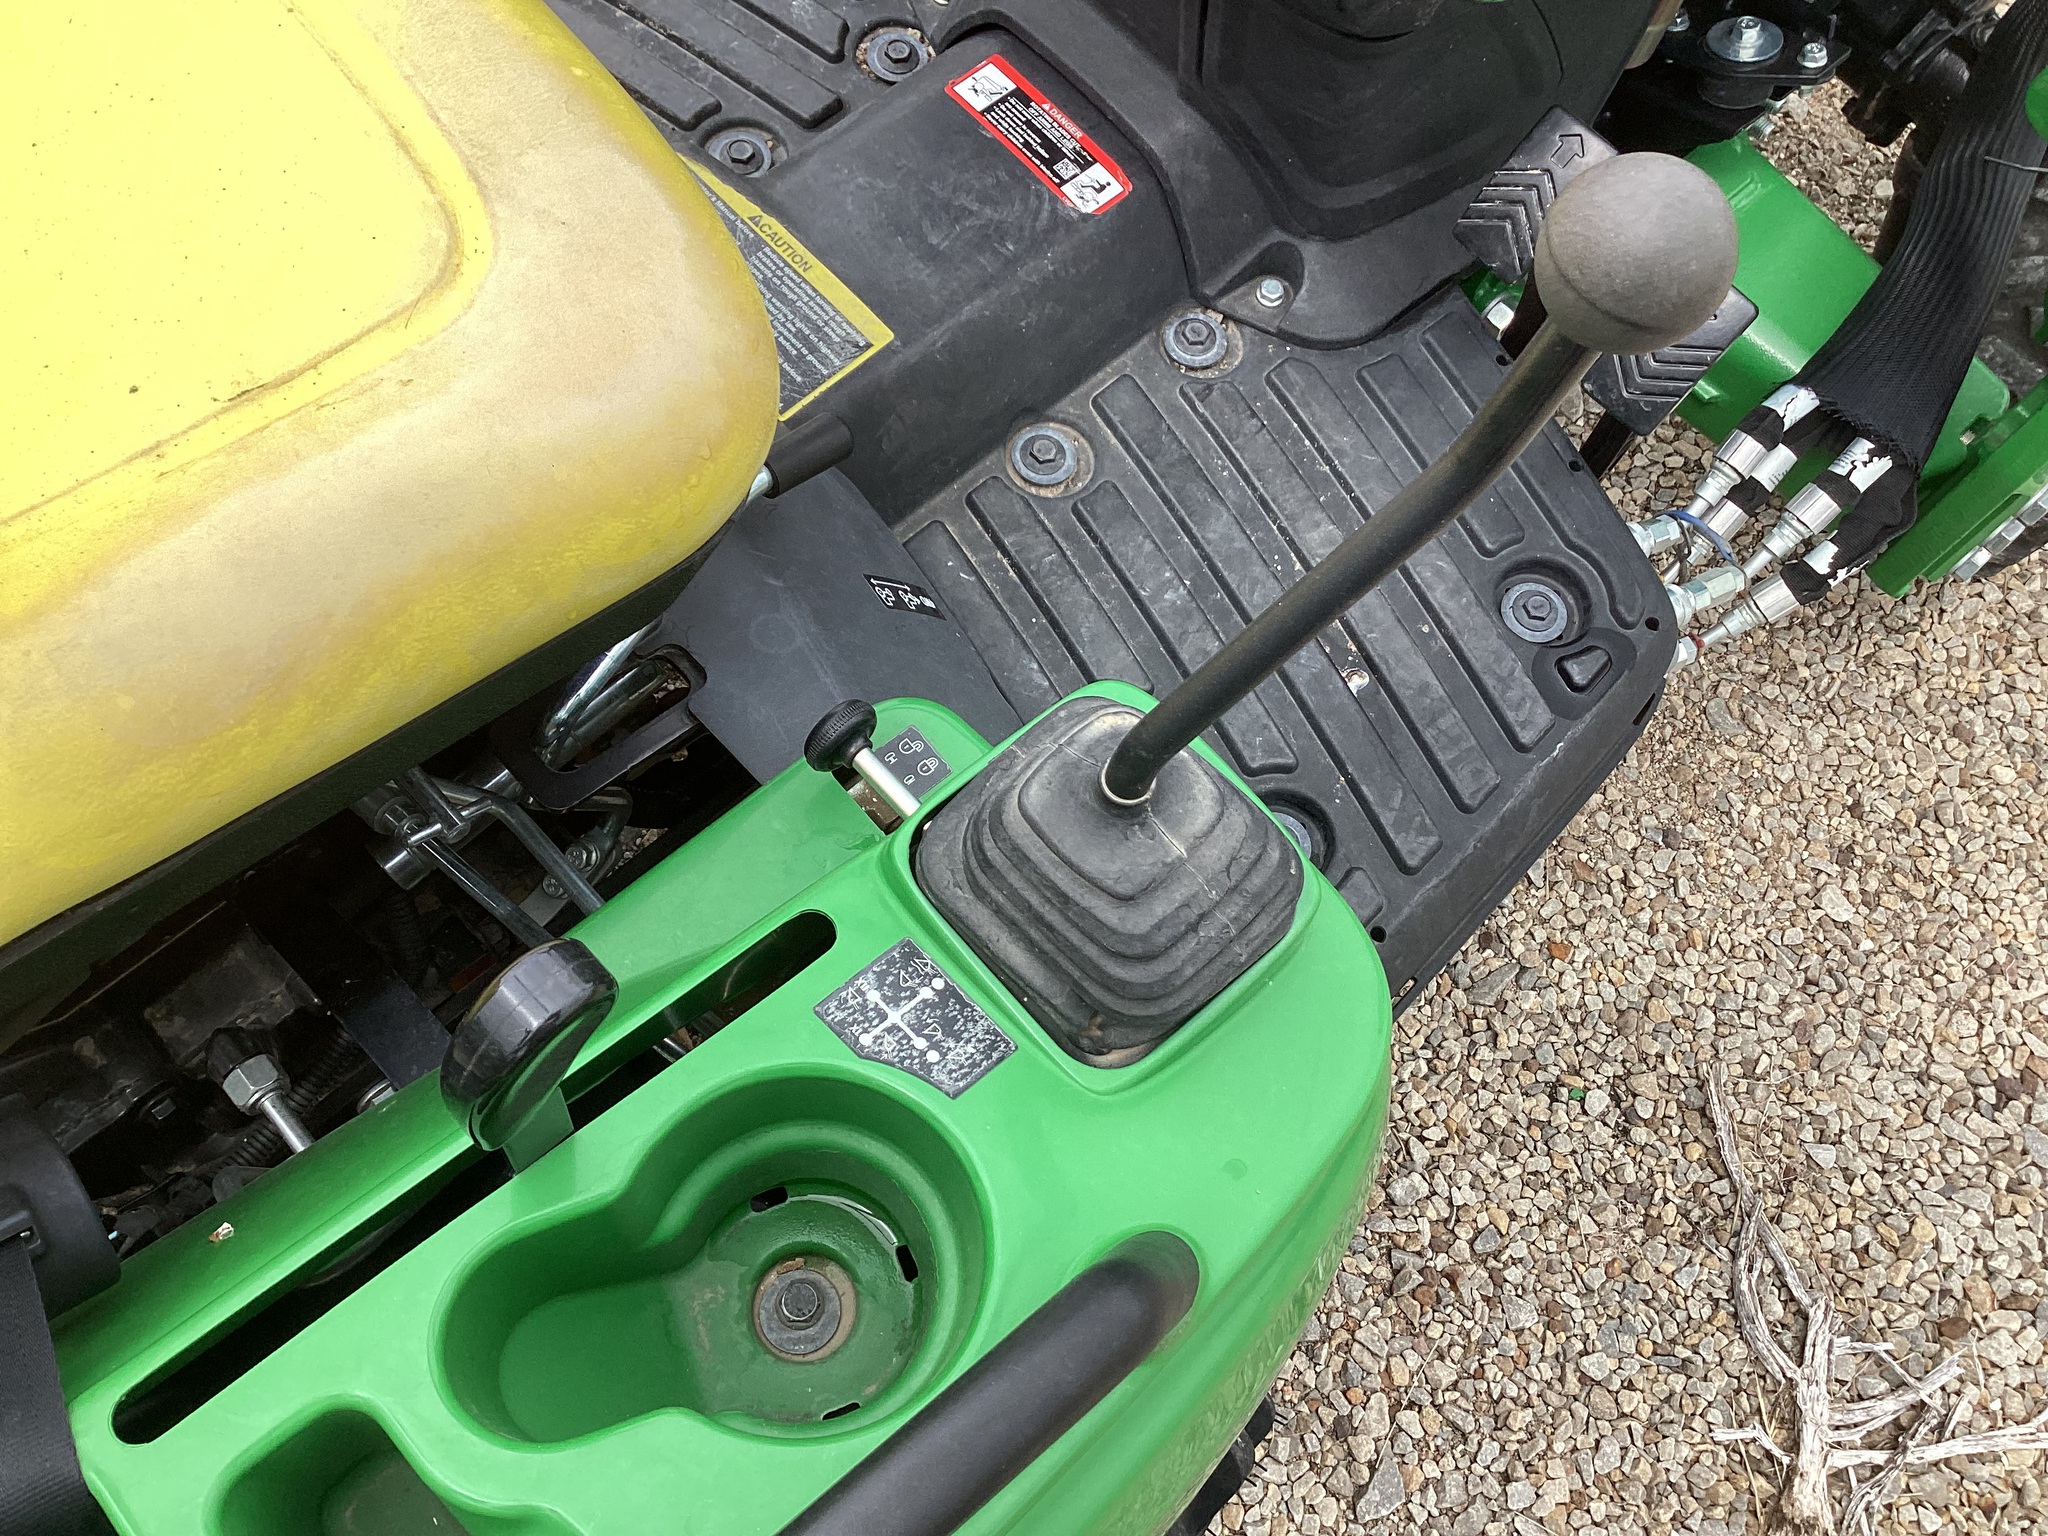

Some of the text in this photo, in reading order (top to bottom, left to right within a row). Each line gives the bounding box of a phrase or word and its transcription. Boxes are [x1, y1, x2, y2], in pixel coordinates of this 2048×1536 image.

[1029, 108, 1039, 116] OFF
[1037, 116, 1051, 128] ARMS
[1051, 128, 1061, 137] AND
[1030, 102, 1053, 123] ROTATING
[1052, 122, 1071, 139] BLADES
[1042, 129, 1057, 143] children
[1050, 109, 1082, 138] DANGER
[715, 201, 737, 221] Manual
[735, 220, 754, 238] before
[759, 224, 812, 272] CAUTION
[750, 256, 772, 277] hazards
[772, 277, 781, 285] on
[780, 285, 798, 301] rough
[796, 301, 818, 320] ground
[823, 326, 840, 342] steep
[757, 251, 776, 270] brakes
[783, 276, 809, 302] operating
[808, 301, 830, 320] around
[828, 320, 846, 336] rough
[763, 247, 784, 267] Reduce
[784, 267, 802, 283] speed
[800, 282, 816, 297] when
[815, 296, 835, 316] turning
[841, 322, 865, 346] applying
[771, 297, 794, 320] warning
[793, 317, 810, 334] lights
[809, 334, 818, 342] on
[817, 341, 841, 365] highway
[777, 313, 786, 322] by
[785, 321, 796, 333] law.
[773, 320, 802, 348] implement
[806, 354, 829, 375] ground
[778, 336, 797, 355] before
[782, 362, 802, 382] before
